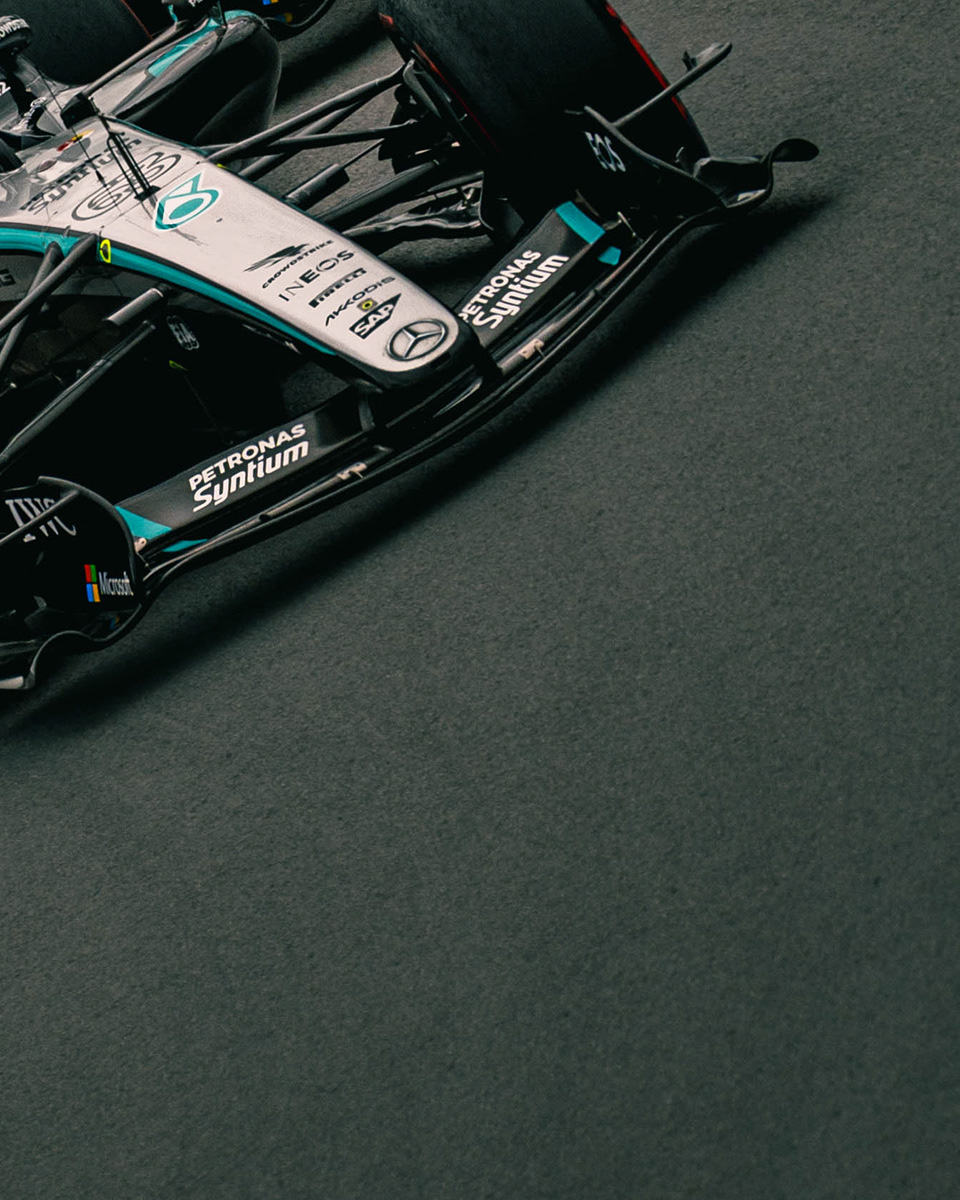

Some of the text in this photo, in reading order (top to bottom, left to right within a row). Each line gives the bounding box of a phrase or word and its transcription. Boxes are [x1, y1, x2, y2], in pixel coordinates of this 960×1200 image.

[261, 240, 333, 289] CROWDSTRIKE
[278, 250, 355, 302] INEOS
[458, 250, 541, 323] PETRONAS
[472, 254, 570, 329] Syntium
[353, 303, 394, 338] SAP
[188, 423, 307, 491] PETRONAS
[192, 440, 310, 513] Syntium
[98, 571, 134, 596] Microsoft
